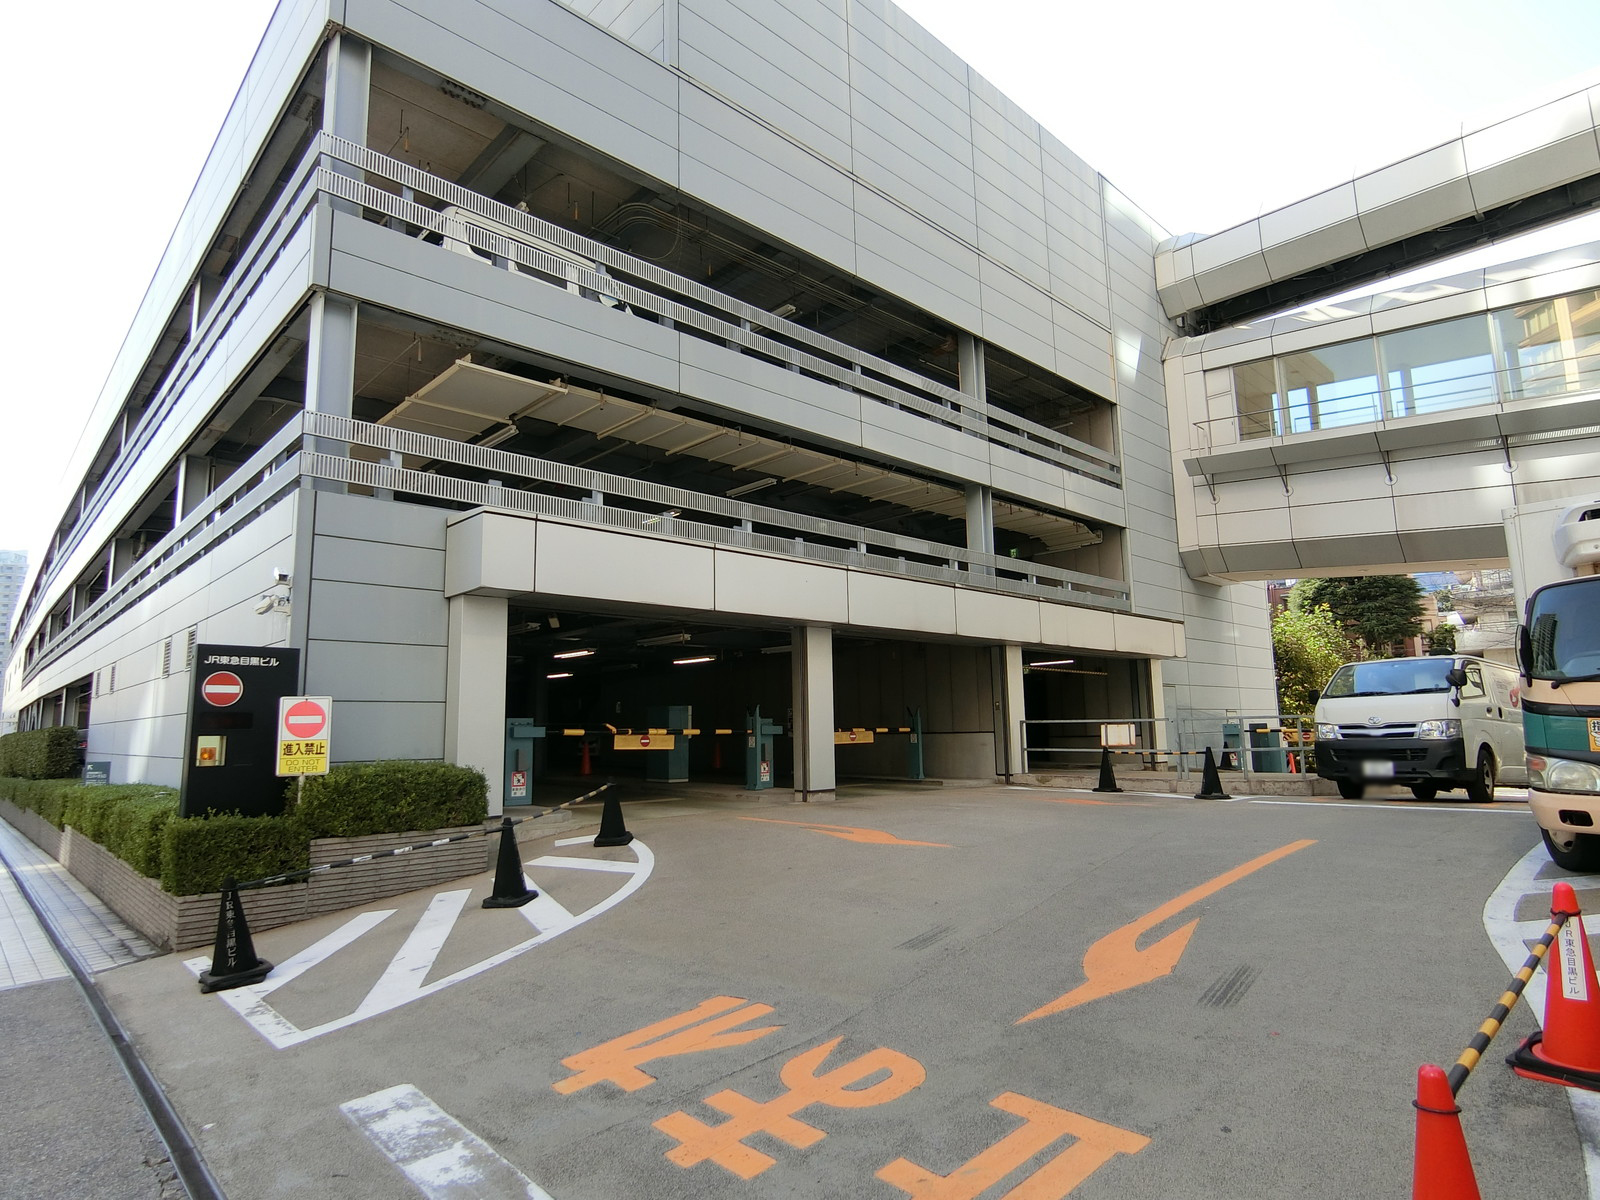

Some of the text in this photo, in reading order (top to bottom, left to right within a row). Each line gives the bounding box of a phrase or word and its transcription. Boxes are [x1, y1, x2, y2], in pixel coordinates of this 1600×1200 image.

[203, 655, 280, 667] JR東急目黒ビル
[283, 742, 325, 756] 進入禁止
[302, 758, 321, 766] NOT
[288, 765, 318, 773] ENTER
[1564, 920, 1580, 995] JR東急目黒ビル
